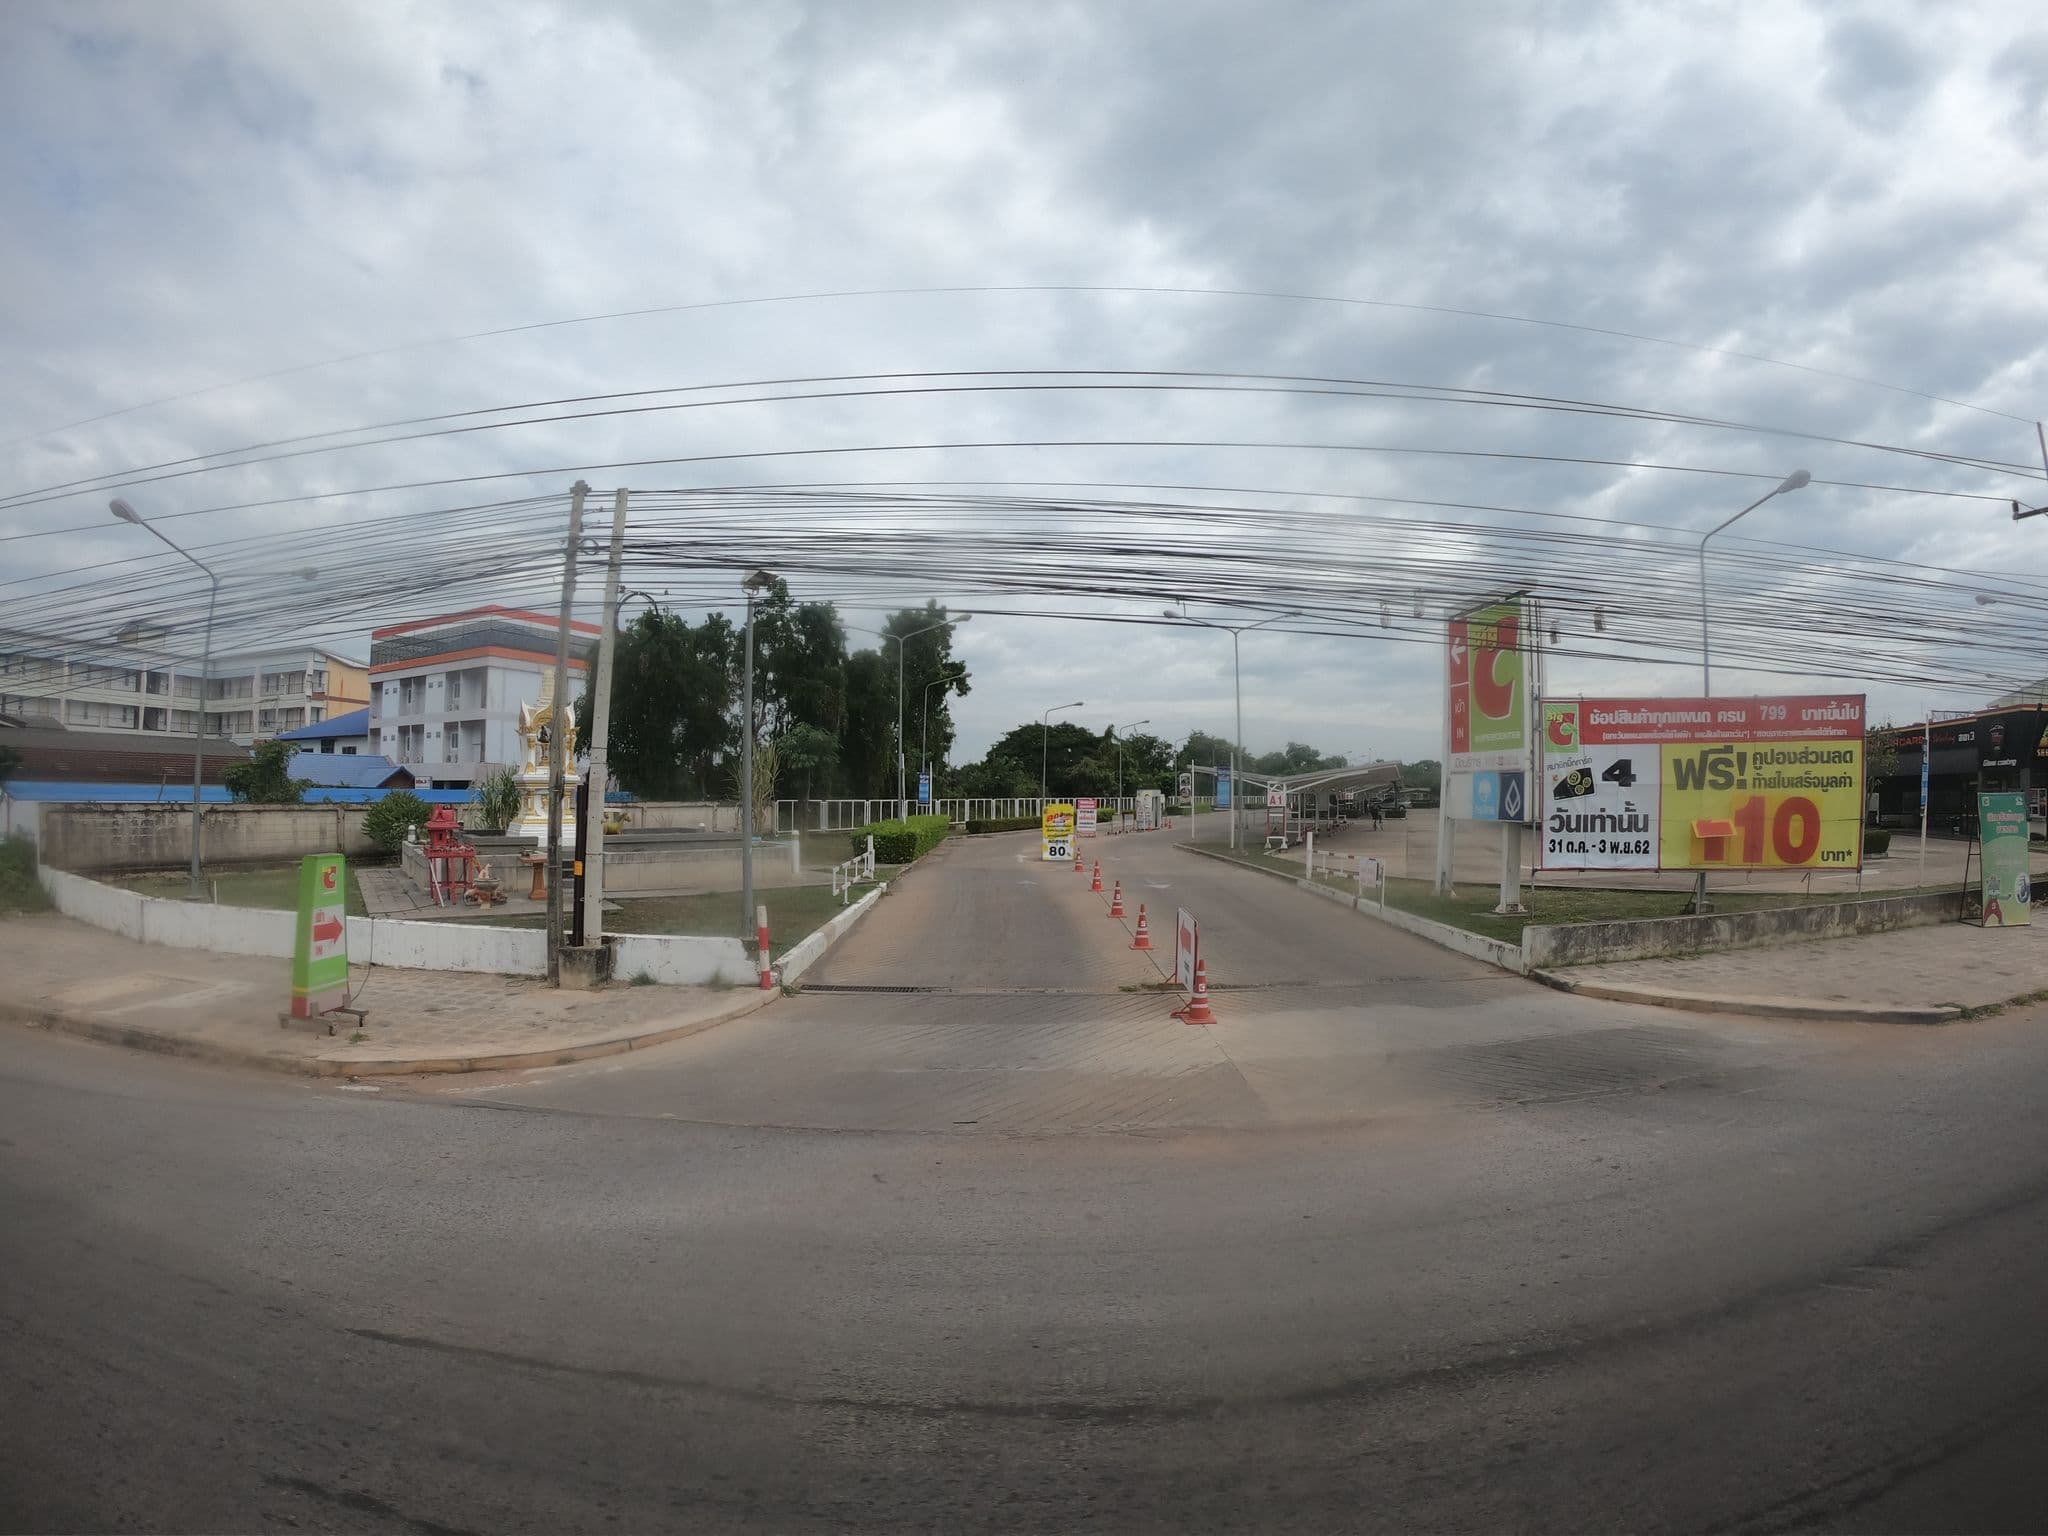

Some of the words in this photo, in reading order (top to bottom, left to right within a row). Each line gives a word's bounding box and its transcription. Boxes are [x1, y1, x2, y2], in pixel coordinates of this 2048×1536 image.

[1717, 710, 1746, 723] ครบ
[1760, 704, 1787, 720] 799
[1456, 727, 1464, 738] IN
[1673, 745, 1747, 790] ฟรี!
[1753, 747, 1853, 770] คูปองส่วนลด
[1602, 759, 1636, 787] 4
[1753, 771, 1852, 792] ท้ายใบเสร็จมูลค่า
[1550, 801, 1649, 833] วันเท่านั้น
[1049, 846, 1066, 857] 80
[1549, 839, 1563, 853] 31
[1599, 840, 1607, 853] 3
